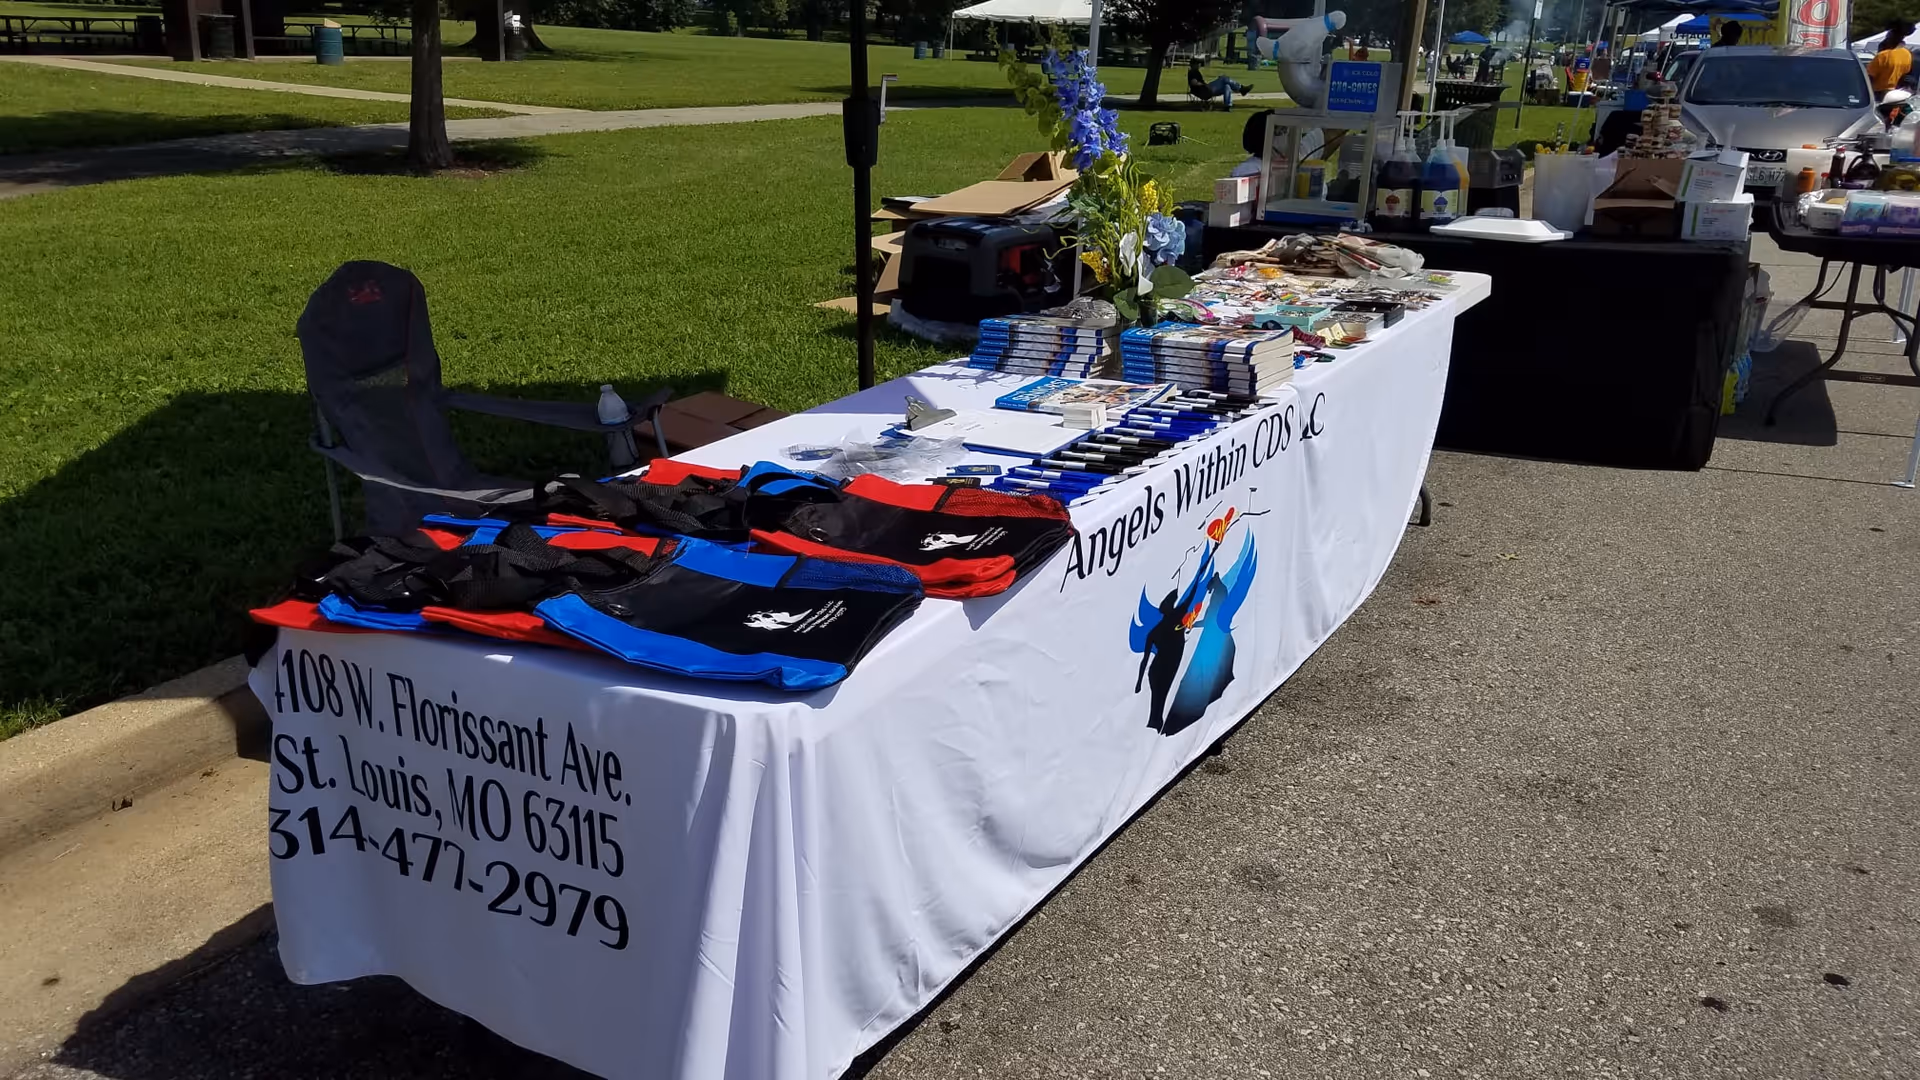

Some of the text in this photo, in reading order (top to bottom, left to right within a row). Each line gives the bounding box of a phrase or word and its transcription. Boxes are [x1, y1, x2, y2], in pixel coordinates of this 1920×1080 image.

[1060, 485, 1165, 594] Angels
[1174, 438, 1246, 519] Within
[1252, 406, 1294, 469] CDS
[275, 733, 624, 878] St. Louis, MO 63115
[341, 659, 384, 732] W.
[387, 672, 551, 782] Florissant
[561, 721, 631, 806] Ave.
[269, 805, 630, 951] 314-477-2979
